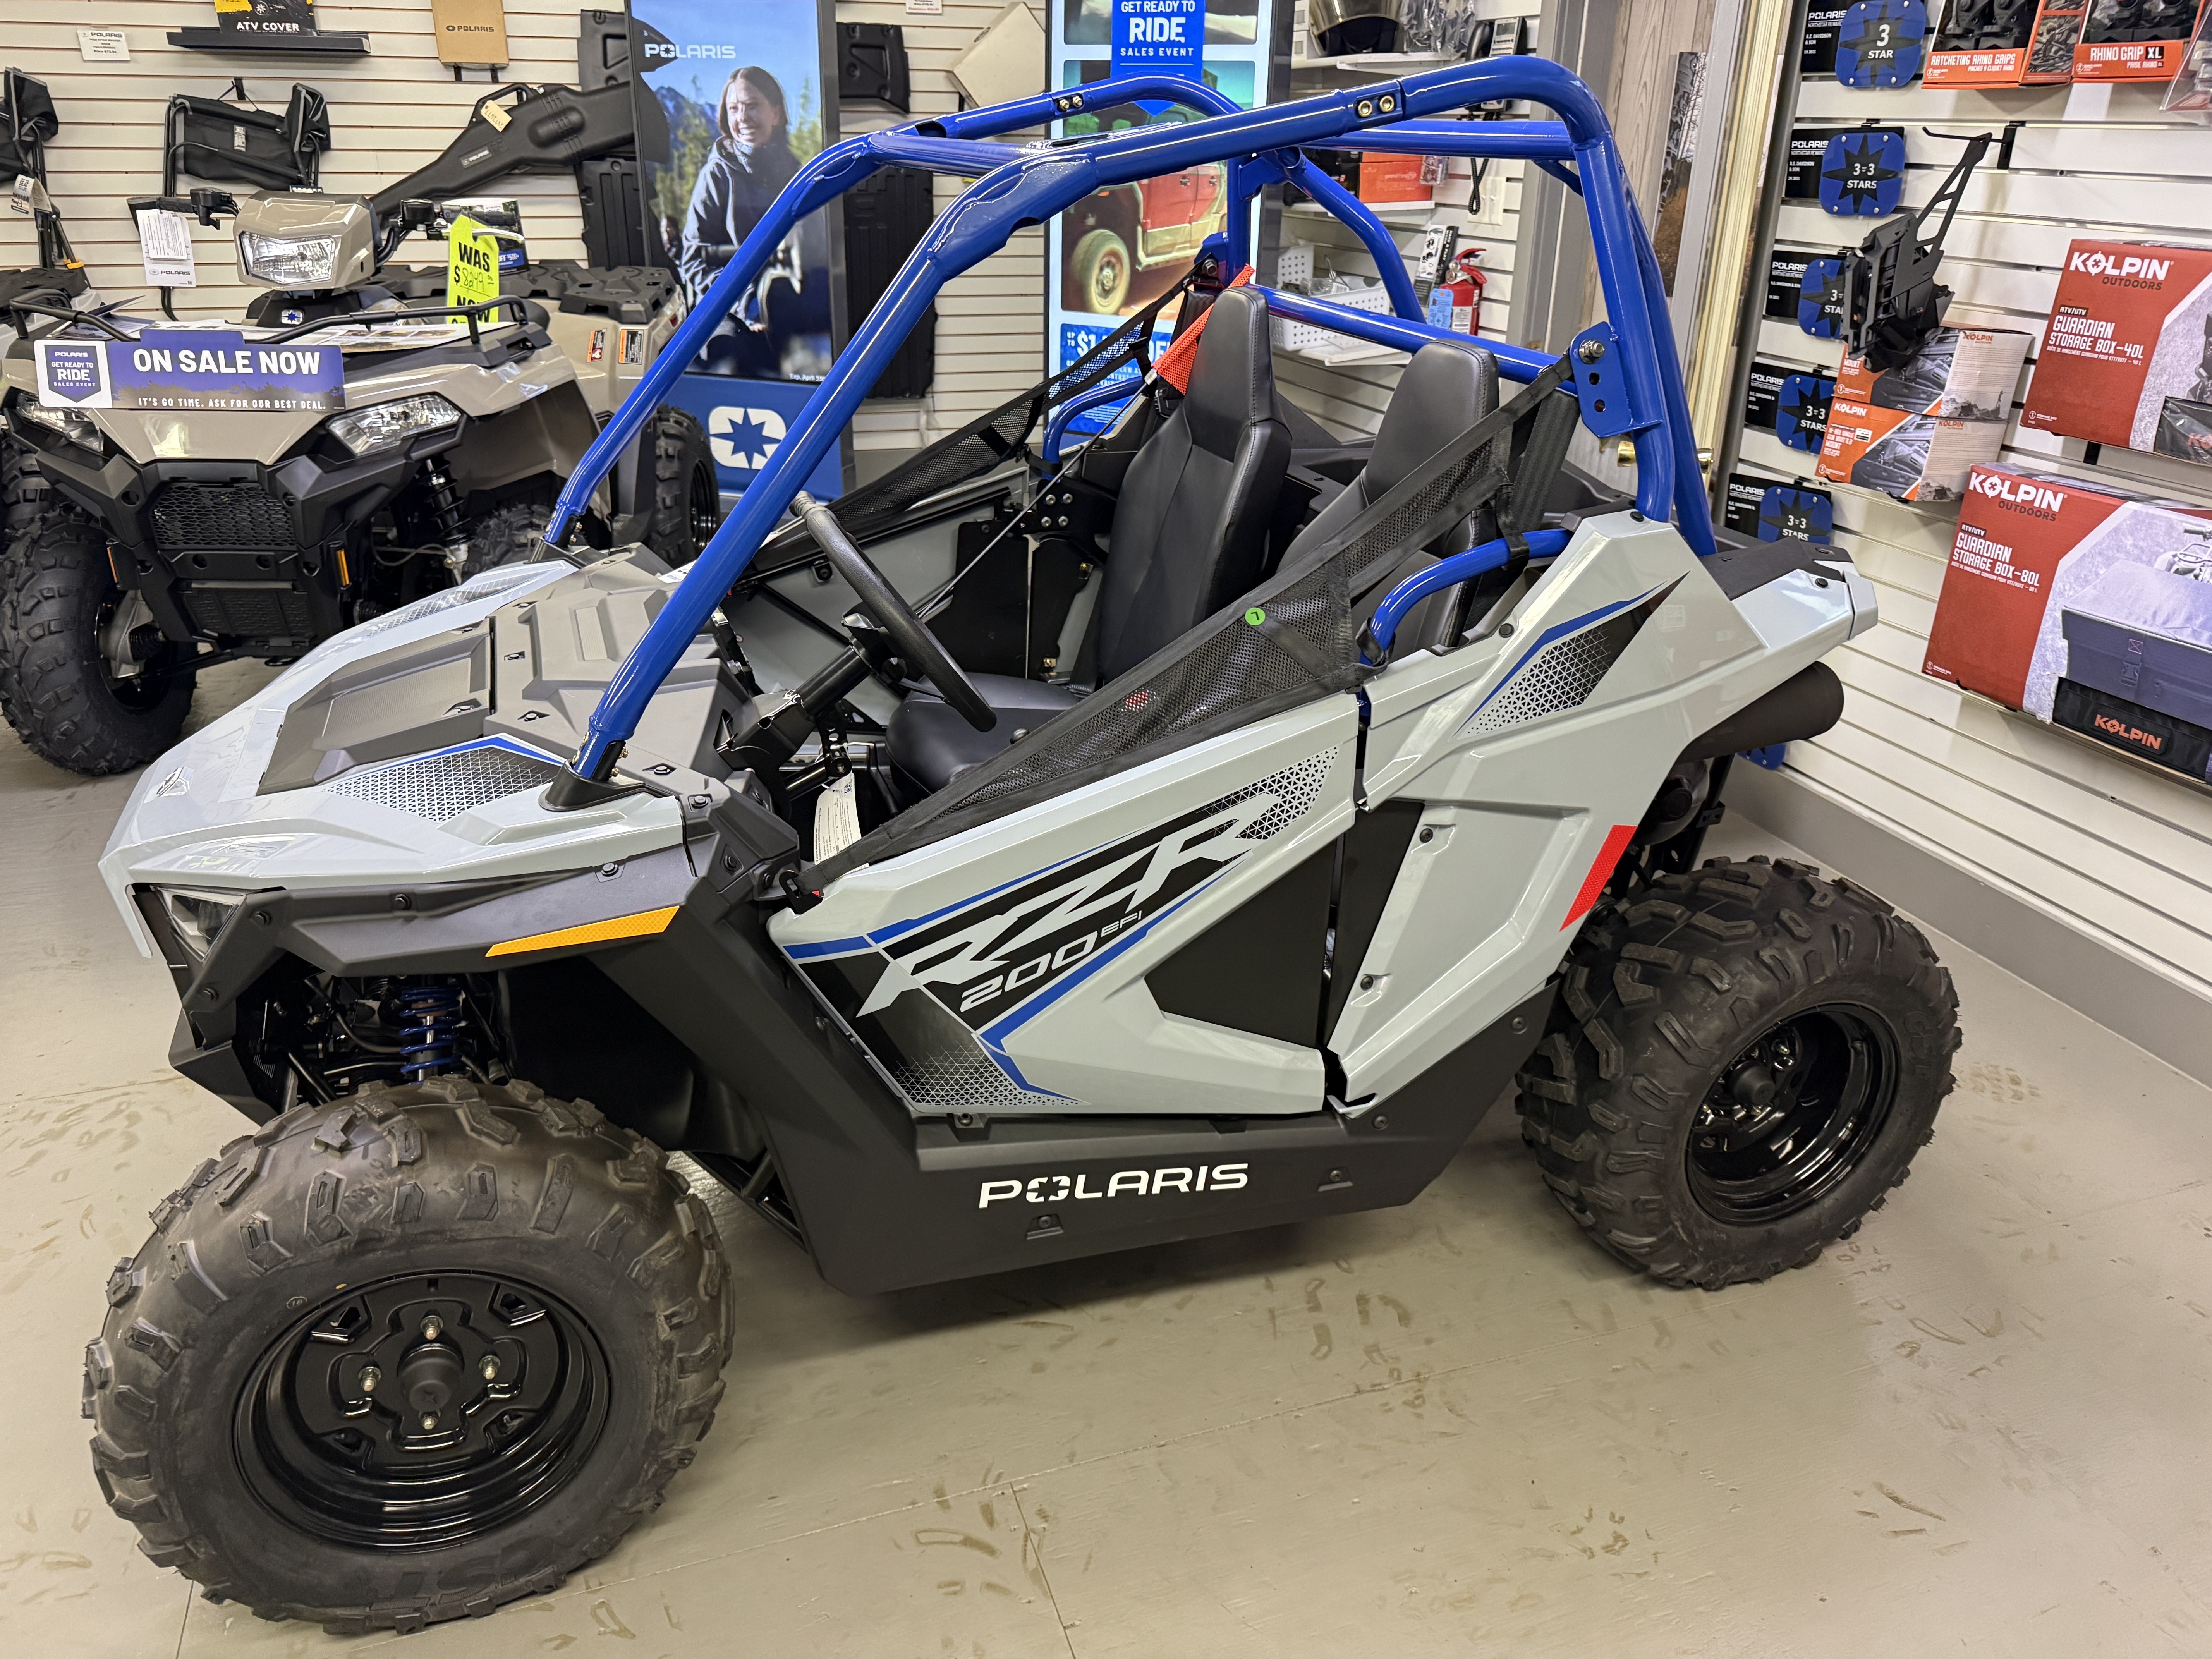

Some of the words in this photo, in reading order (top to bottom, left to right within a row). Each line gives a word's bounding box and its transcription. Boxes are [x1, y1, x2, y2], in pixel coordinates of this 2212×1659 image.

[1121, 1, 1142, 13] GET
[1144, 0, 1180, 12] READY
[1181, 0, 1196, 12] TO
[1808, 10, 1847, 20] POLARIS
[237, 22, 259, 30] ATV
[263, 22, 300, 31] COVER
[1129, 17, 1186, 43] RIDE
[1877, 24, 1890, 46] 3
[644, 43, 737, 59] POLARIS
[1120, 48, 1154, 56] SALES
[1159, 48, 1194, 56] EVENT
[1868, 50, 1893, 59] STAR
[2090, 47, 2119, 61] RHINO
[2120, 46, 2144, 60] GRIP
[2147, 47, 2162, 59] XL
[1931, 55, 1971, 65] RATCHETING
[1972, 54, 1993, 65] RHINO
[1994, 53, 2016, 64] GRIPS
[1846, 180, 1878, 189] STARS
[458, 242, 490, 272] WAS
[1772, 261, 1808, 271] POLARIS
[2069, 251, 2171, 280] KOLPIN
[2102, 276, 2163, 291] OUTDOORS
[1824, 305, 1843, 314] STA
[2060, 306, 2087, 316] ATV/UTV
[2052, 315, 2116, 339] GUARDIAN
[1963, 332, 1993, 342] KOLPIN
[2049, 332, 2094, 351] STORAGE
[133, 349, 173, 373] ON
[179, 349, 254, 374] SALE
[258, 351, 321, 375] NOW
[57, 369, 90, 381] RIDE
[1751, 373, 1785, 385] POLARIS
[138, 397, 158, 407] IT'S
[161, 398, 173, 407] GO
[178, 398, 204, 407] TIME.
[208, 399, 226, 408] ASK
[230, 399, 248, 408] FOR
[252, 400, 270, 408] OUR
[274, 400, 296, 409] BEST
[301, 400, 326, 409] DEAL.
[1834, 402, 1868, 416] KOLPIN
[1800, 419, 1827, 432] STARS
[1729, 483, 1765, 496] POLARIS
[1968, 472, 2063, 512] KOLPIN
[1998, 500, 2057, 522] OUTDOORS
[1782, 529, 1810, 541] STARS
[1956, 532, 2013, 563] GUARDIAN
[1953, 548, 1993, 572] STORAGE
[2094, 713, 2163, 750] KOLPIN
[855, 792, 1282, 1018] RZR
[960, 930, 1098, 1012] 200
[1100, 910, 1143, 937] EFI
[978, 1163, 1249, 1209] POLARIS
